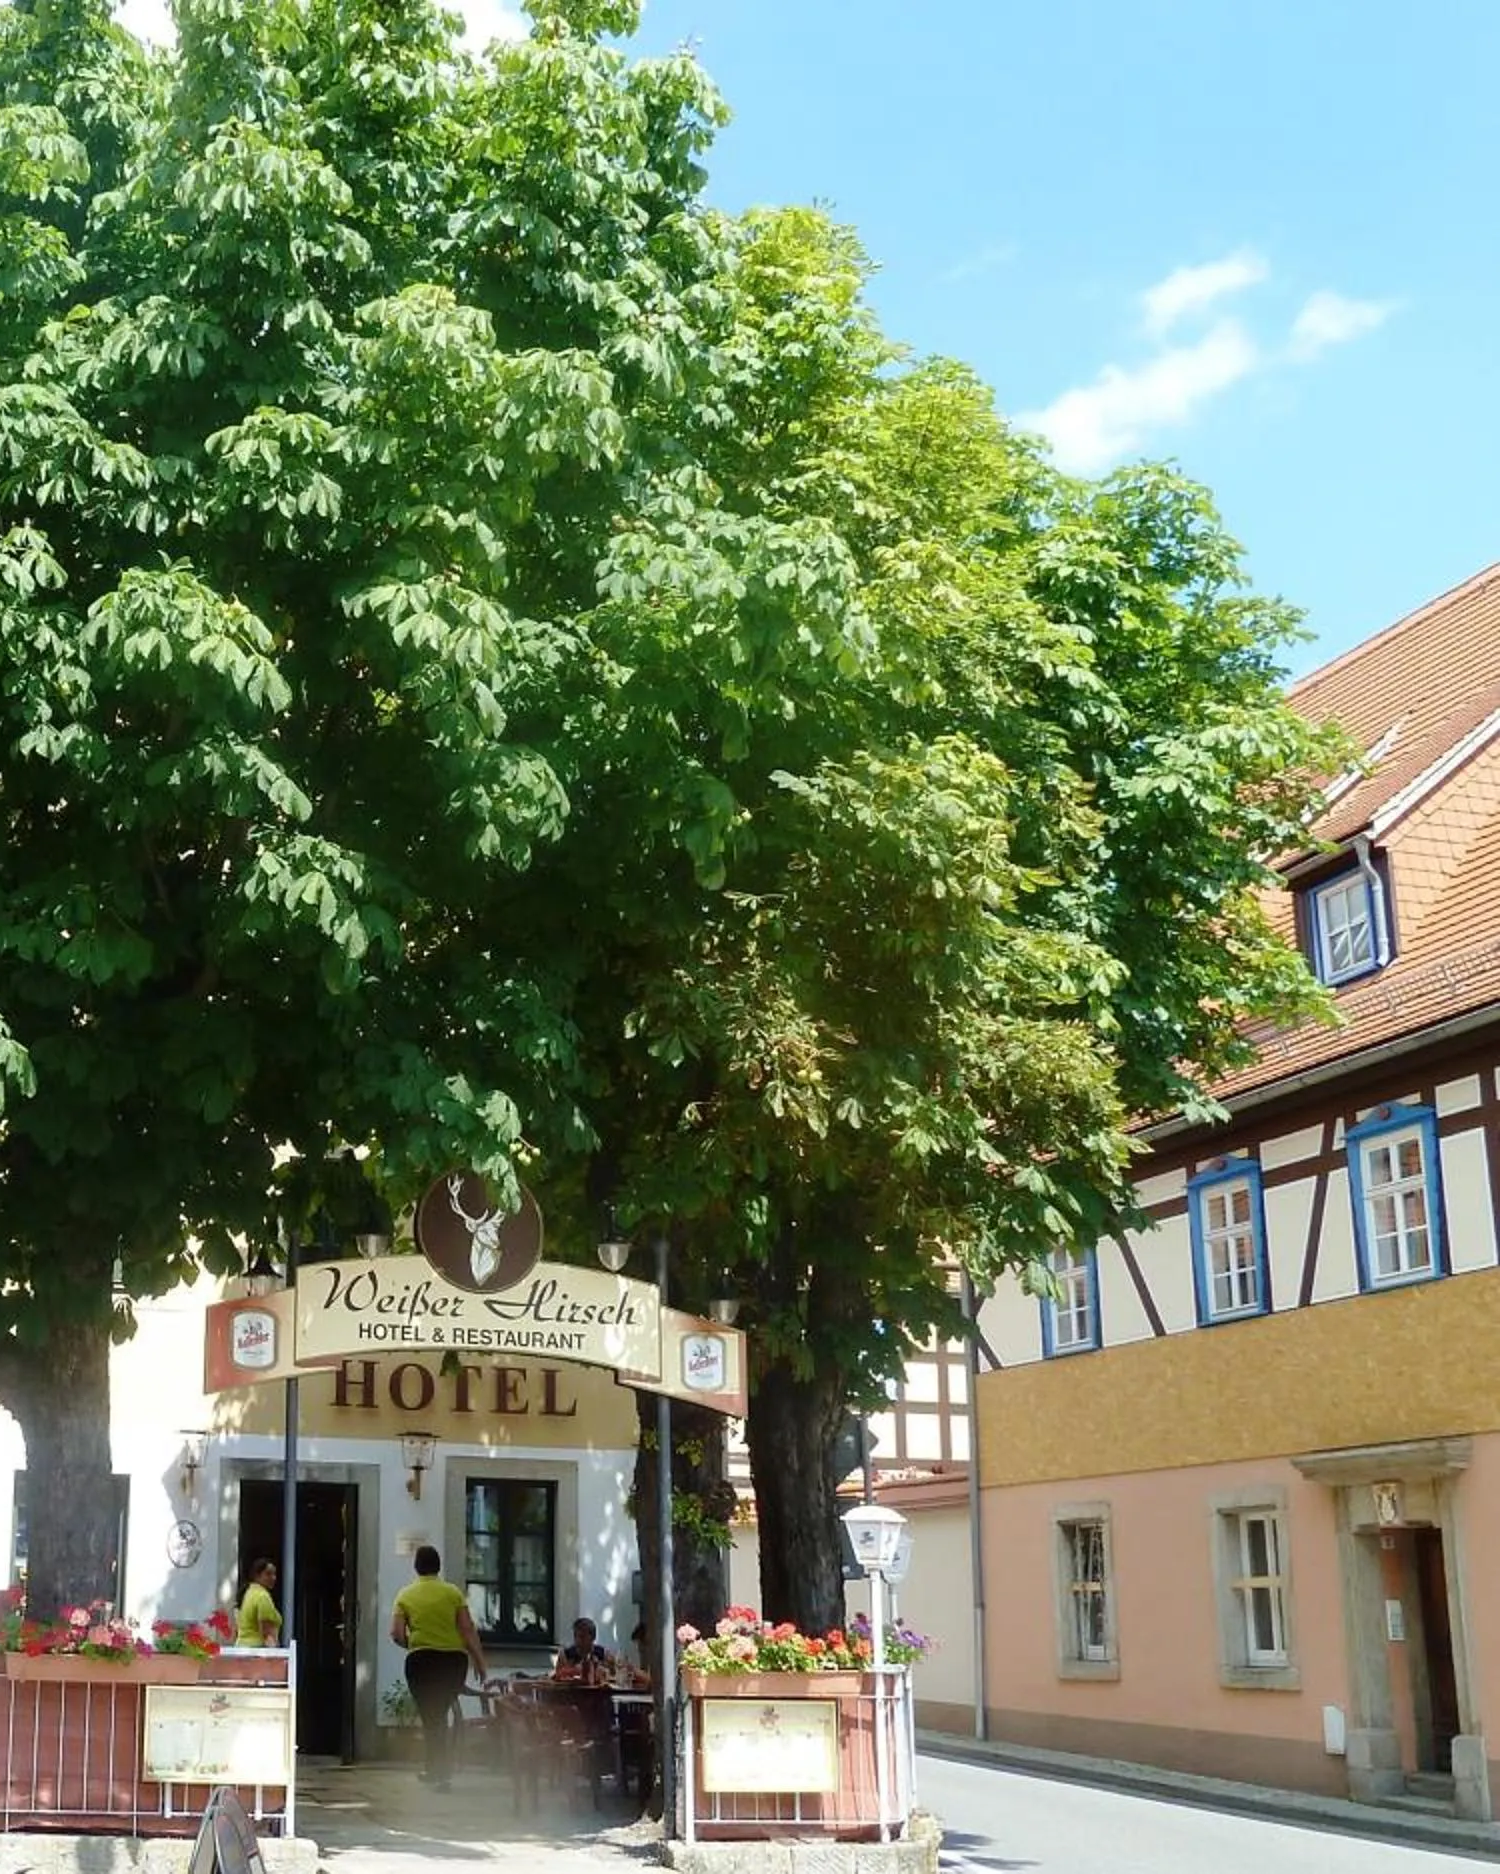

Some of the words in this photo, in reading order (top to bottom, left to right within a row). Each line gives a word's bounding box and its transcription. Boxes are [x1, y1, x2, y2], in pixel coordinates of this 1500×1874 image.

[316, 1266, 465, 1324] Weißer
[484, 1278, 638, 1326] Hirsch
[359, 1323, 426, 1343] HOTEL
[432, 1327, 445, 1343] &
[452, 1328, 587, 1351] RESTAURANT
[329, 1358, 579, 1418] HOTEL
